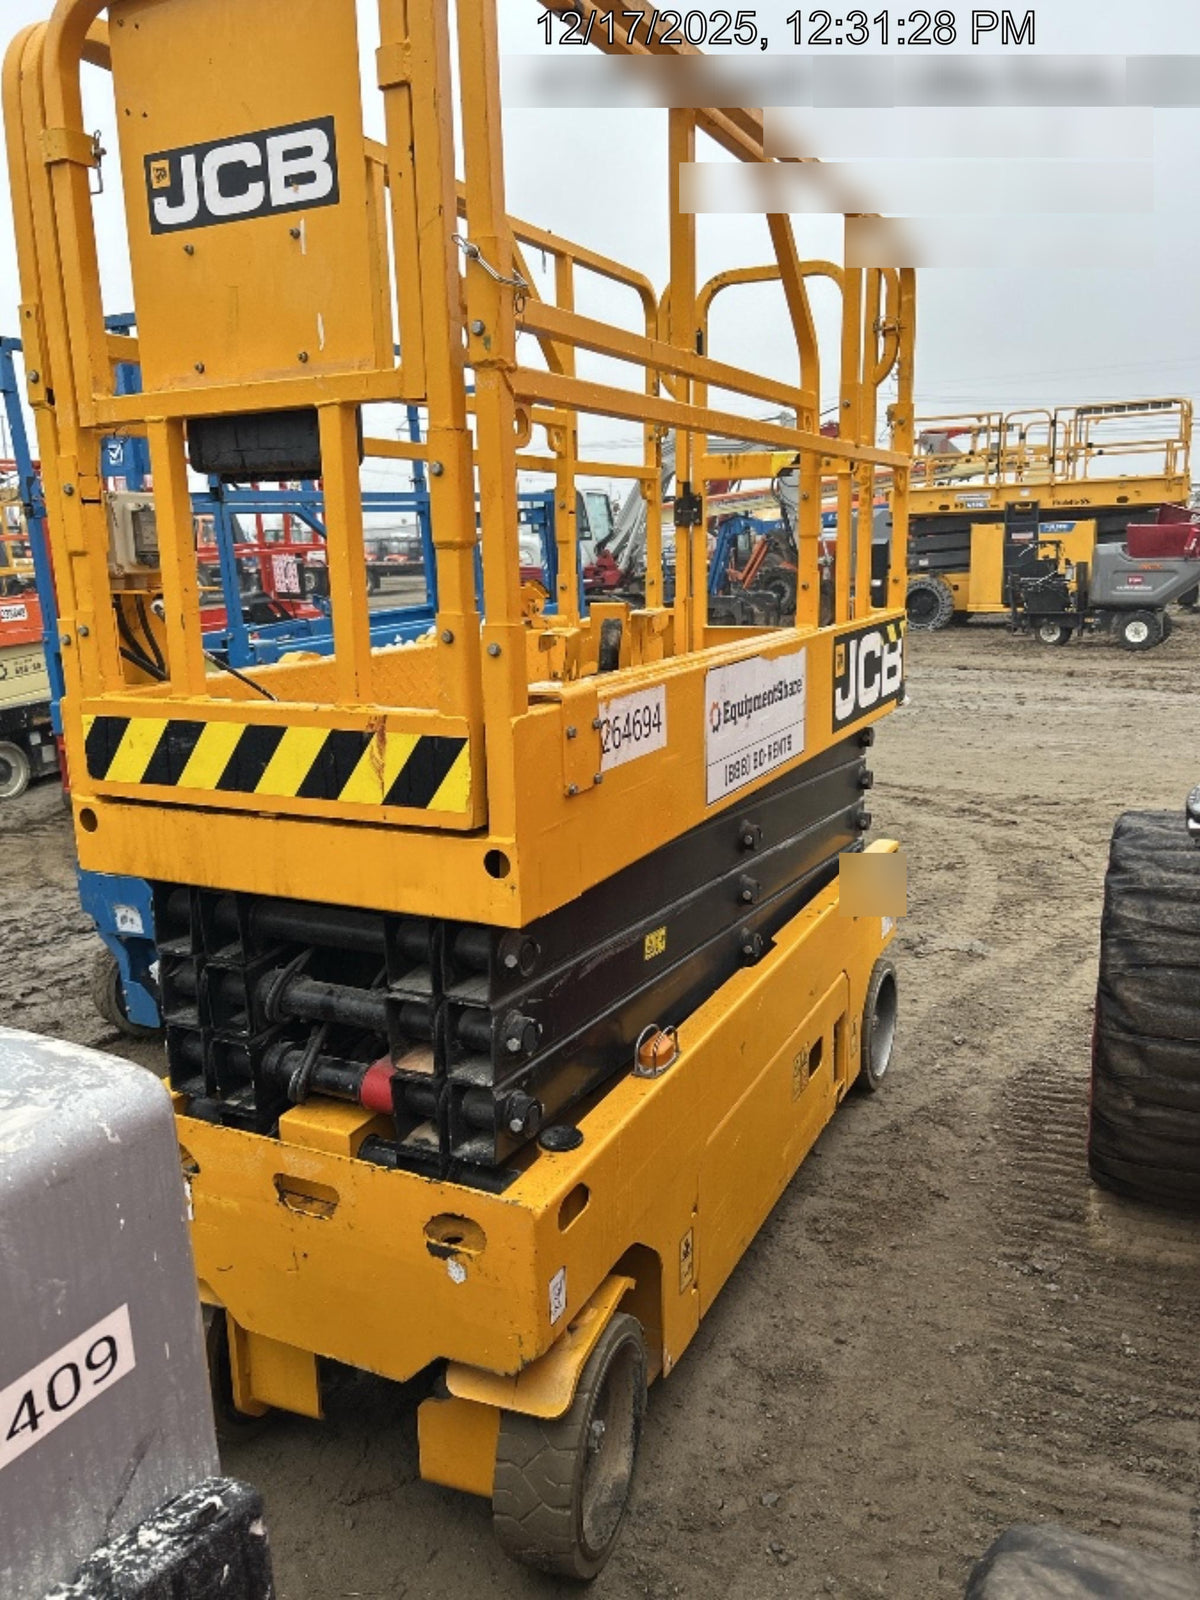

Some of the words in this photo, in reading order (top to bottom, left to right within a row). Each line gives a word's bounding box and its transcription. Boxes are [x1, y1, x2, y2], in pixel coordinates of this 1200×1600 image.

[153, 128, 333, 225] JCB
[723, 678, 803, 726] EquipmentShare
[835, 631, 903, 721] JCB
[601, 703, 662, 754] 264694
[6, 1335, 118, 1441] 409
